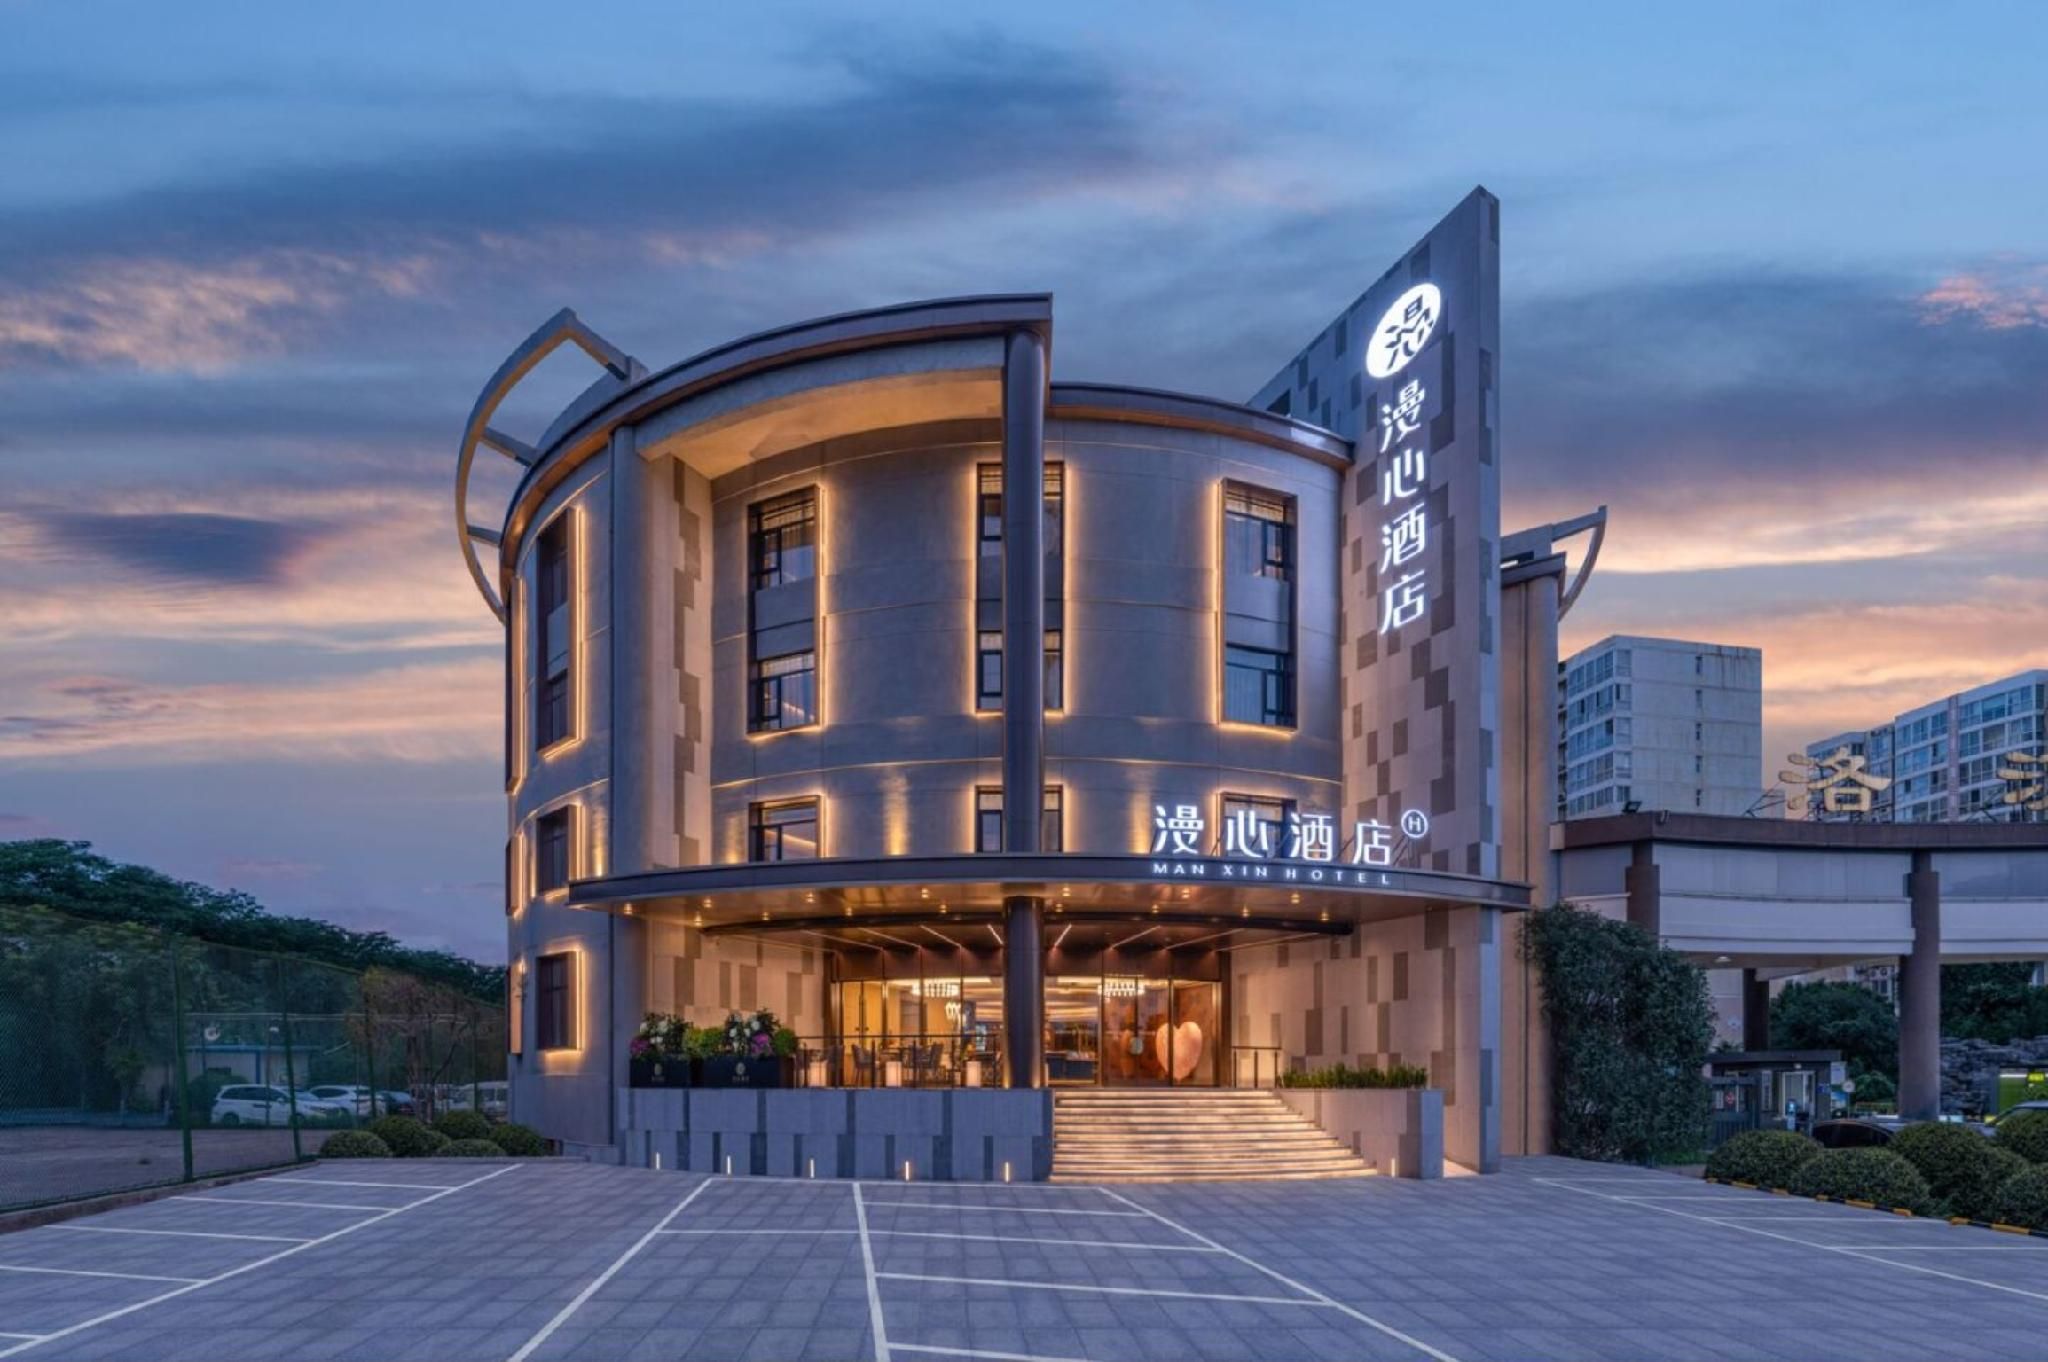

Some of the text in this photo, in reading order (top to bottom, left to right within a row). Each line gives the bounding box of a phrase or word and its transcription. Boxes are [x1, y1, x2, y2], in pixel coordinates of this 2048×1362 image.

[1379, 379, 1426, 636] 漫心酒店
[1154, 804, 1393, 866] 漫心酒店
[1152, 863, 1390, 885] MAN XIN HOTEL
